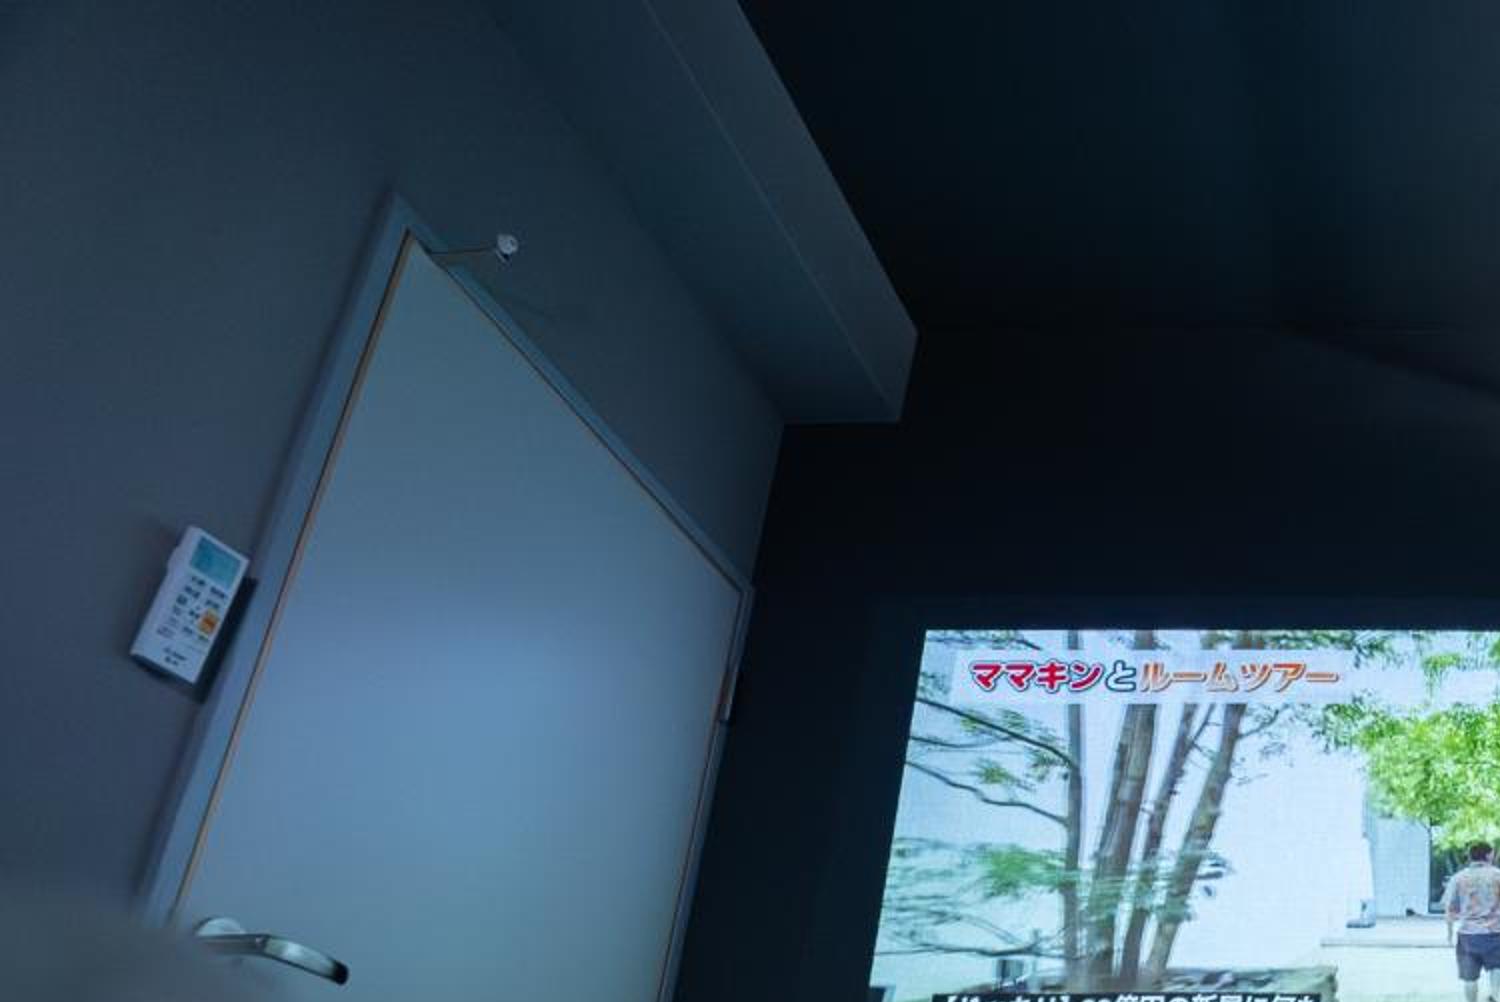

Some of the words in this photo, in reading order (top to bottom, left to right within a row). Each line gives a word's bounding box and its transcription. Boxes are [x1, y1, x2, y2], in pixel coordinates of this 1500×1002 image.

[970, 660, 1339, 693] ママキンとルームツアー
